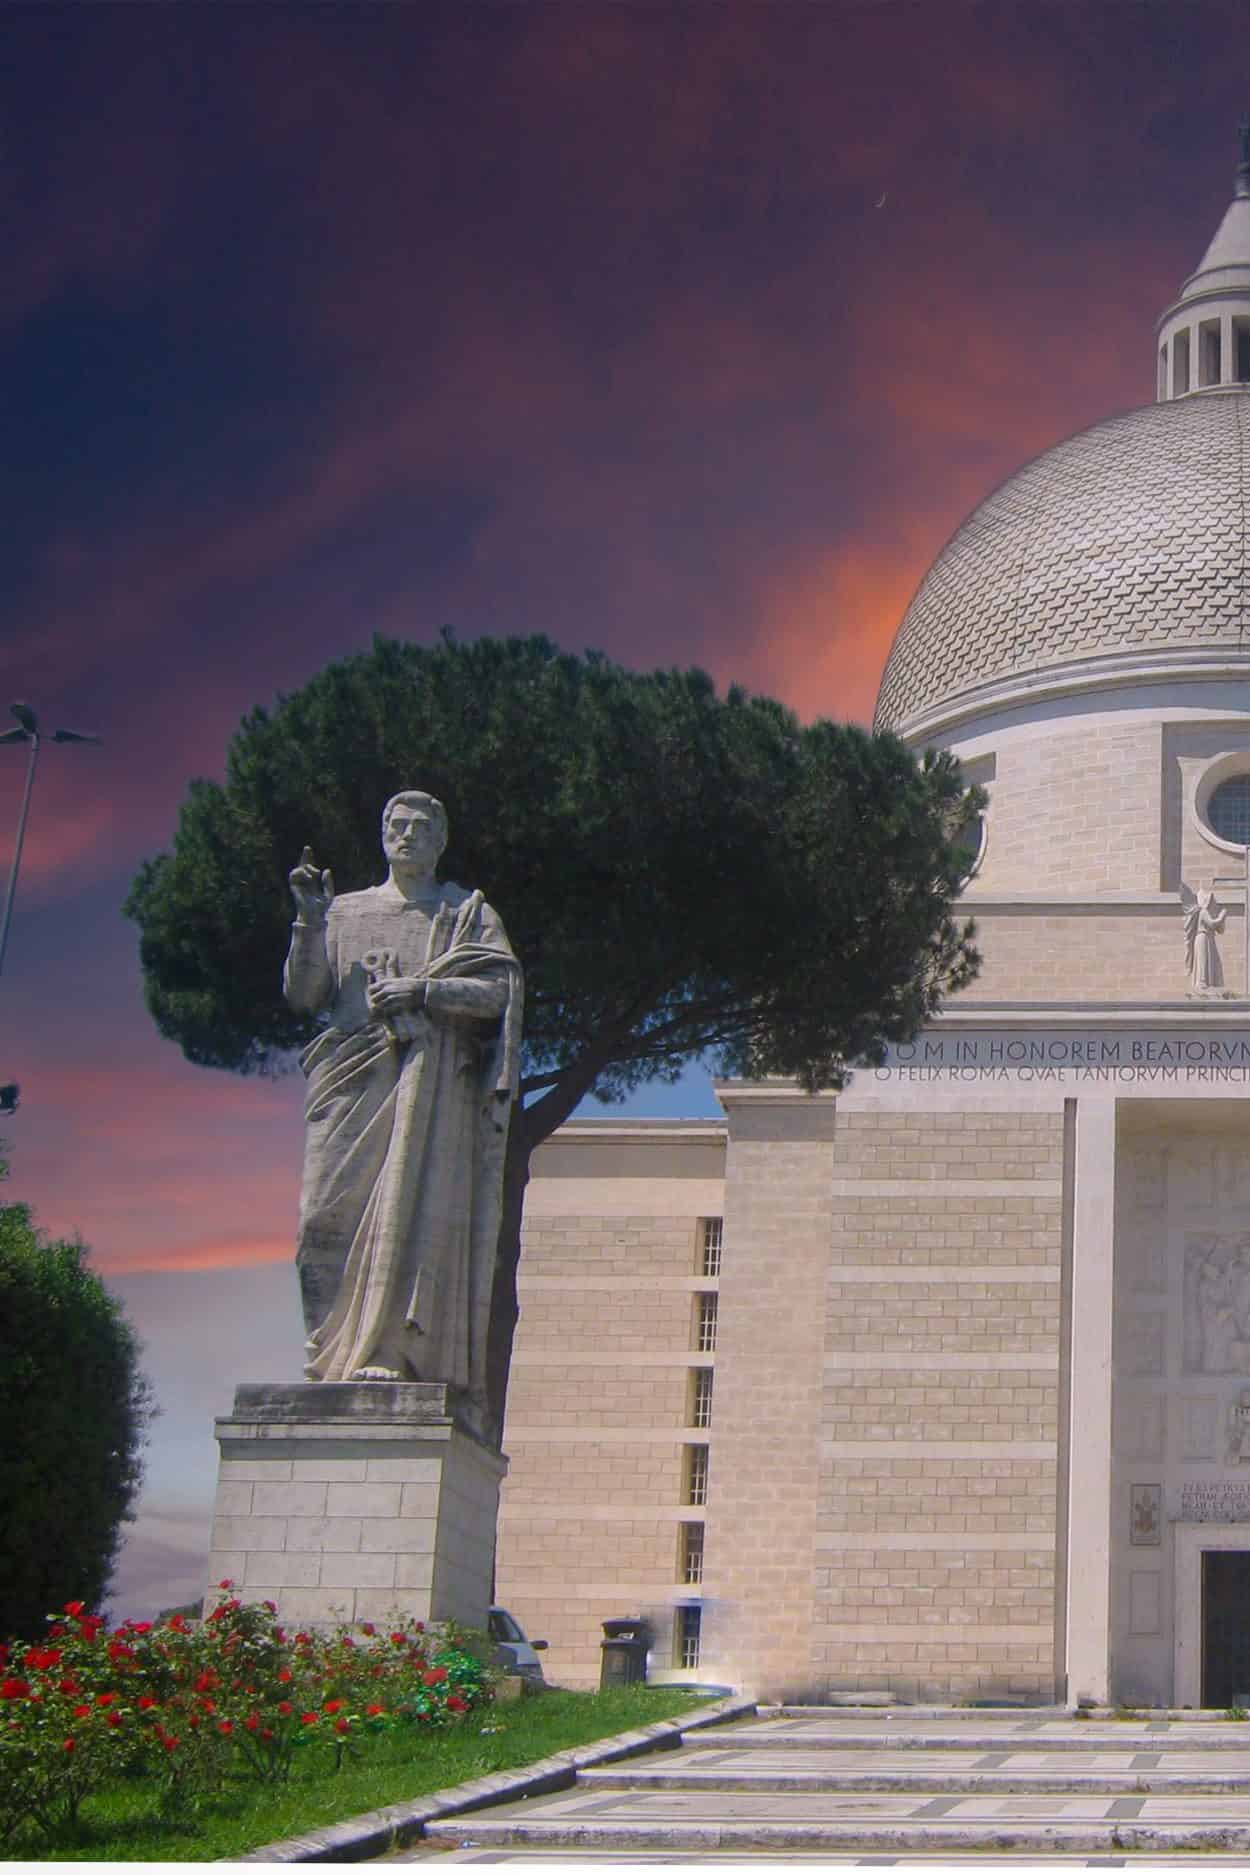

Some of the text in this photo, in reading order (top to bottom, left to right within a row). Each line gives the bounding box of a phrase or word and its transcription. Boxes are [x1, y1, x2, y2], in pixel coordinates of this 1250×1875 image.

[956, 1041, 978, 1062] IN
[990, 1040, 1120, 1062] HONOREM
[875, 1065, 892, 1081] O
[899, 1065, 944, 1081] FELIX
[949, 1065, 1010, 1081] ROMA
[1018, 1065, 1065, 1082] QVAE
[1071, 1065, 1178, 1082] TANTORVM
